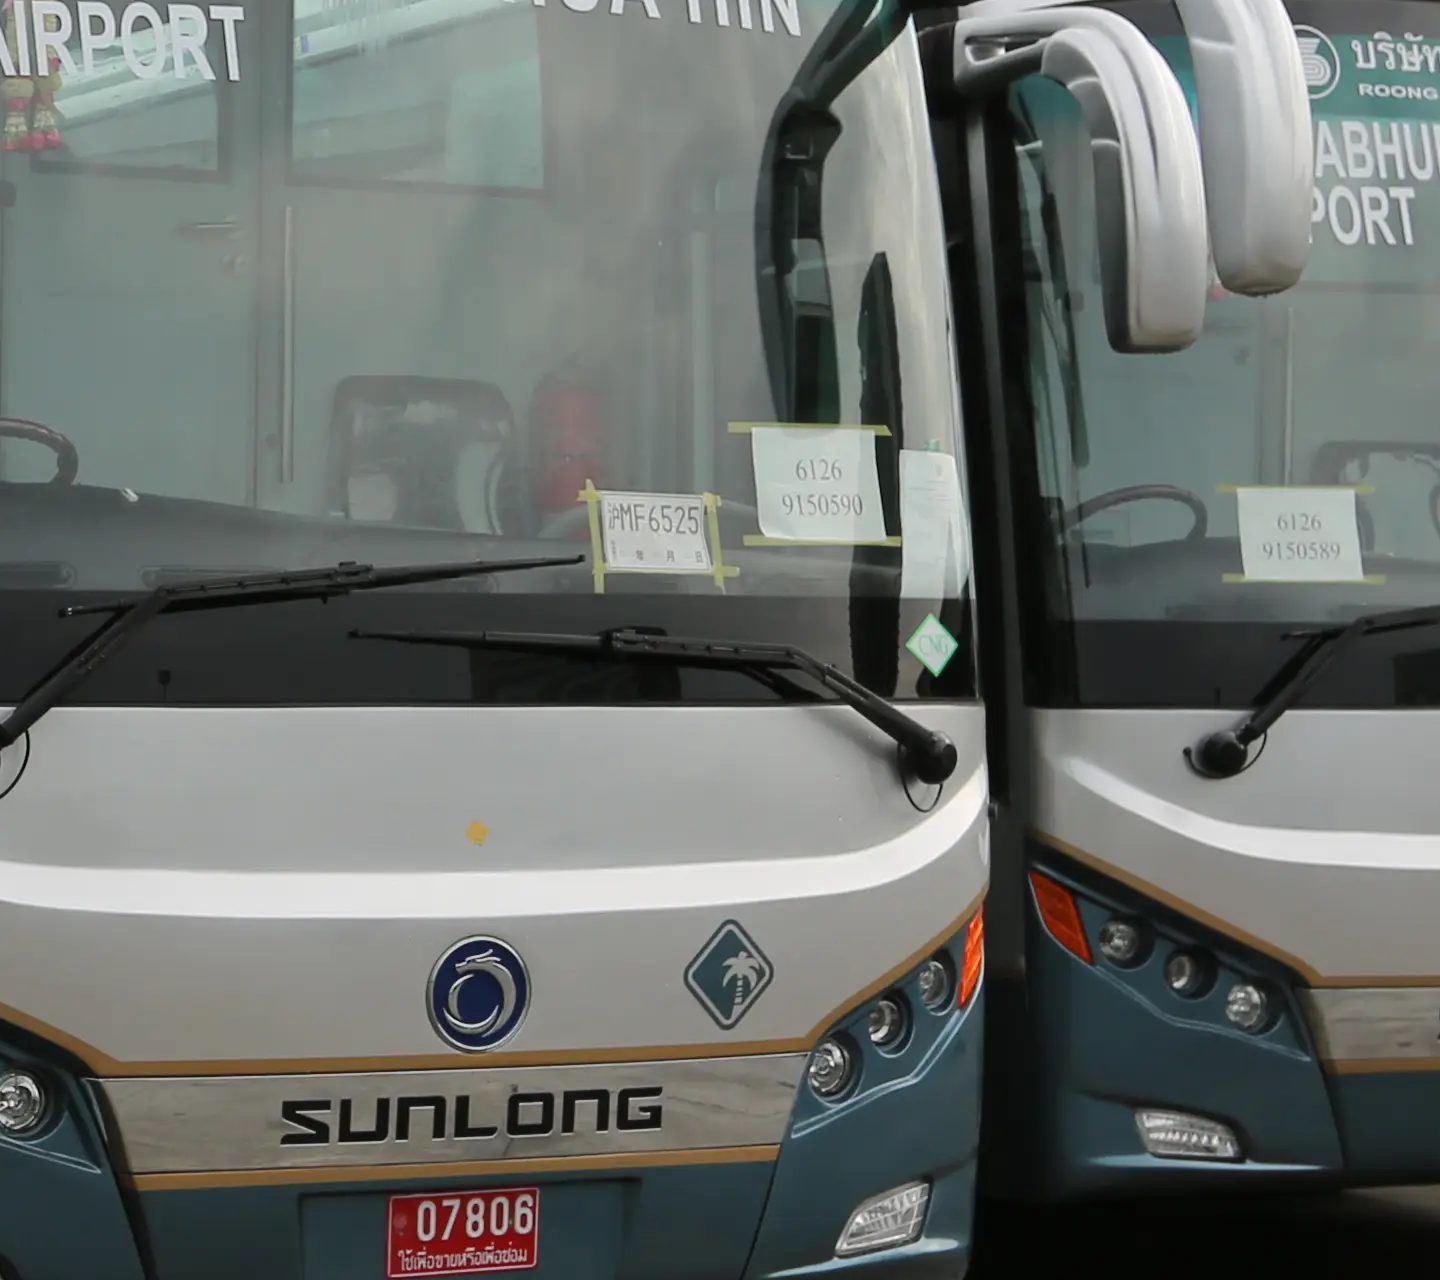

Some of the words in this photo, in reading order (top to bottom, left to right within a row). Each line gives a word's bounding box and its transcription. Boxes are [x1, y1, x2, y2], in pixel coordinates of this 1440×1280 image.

[1358, 83, 1438, 100] ROONG
[796, 458, 843, 481] 6126
[782, 493, 863, 517] 9150590
[1277, 513, 1322, 532] 6126
[280, 1086, 663, 1145] SUNLONG
[417, 1194, 534, 1242] 07806
